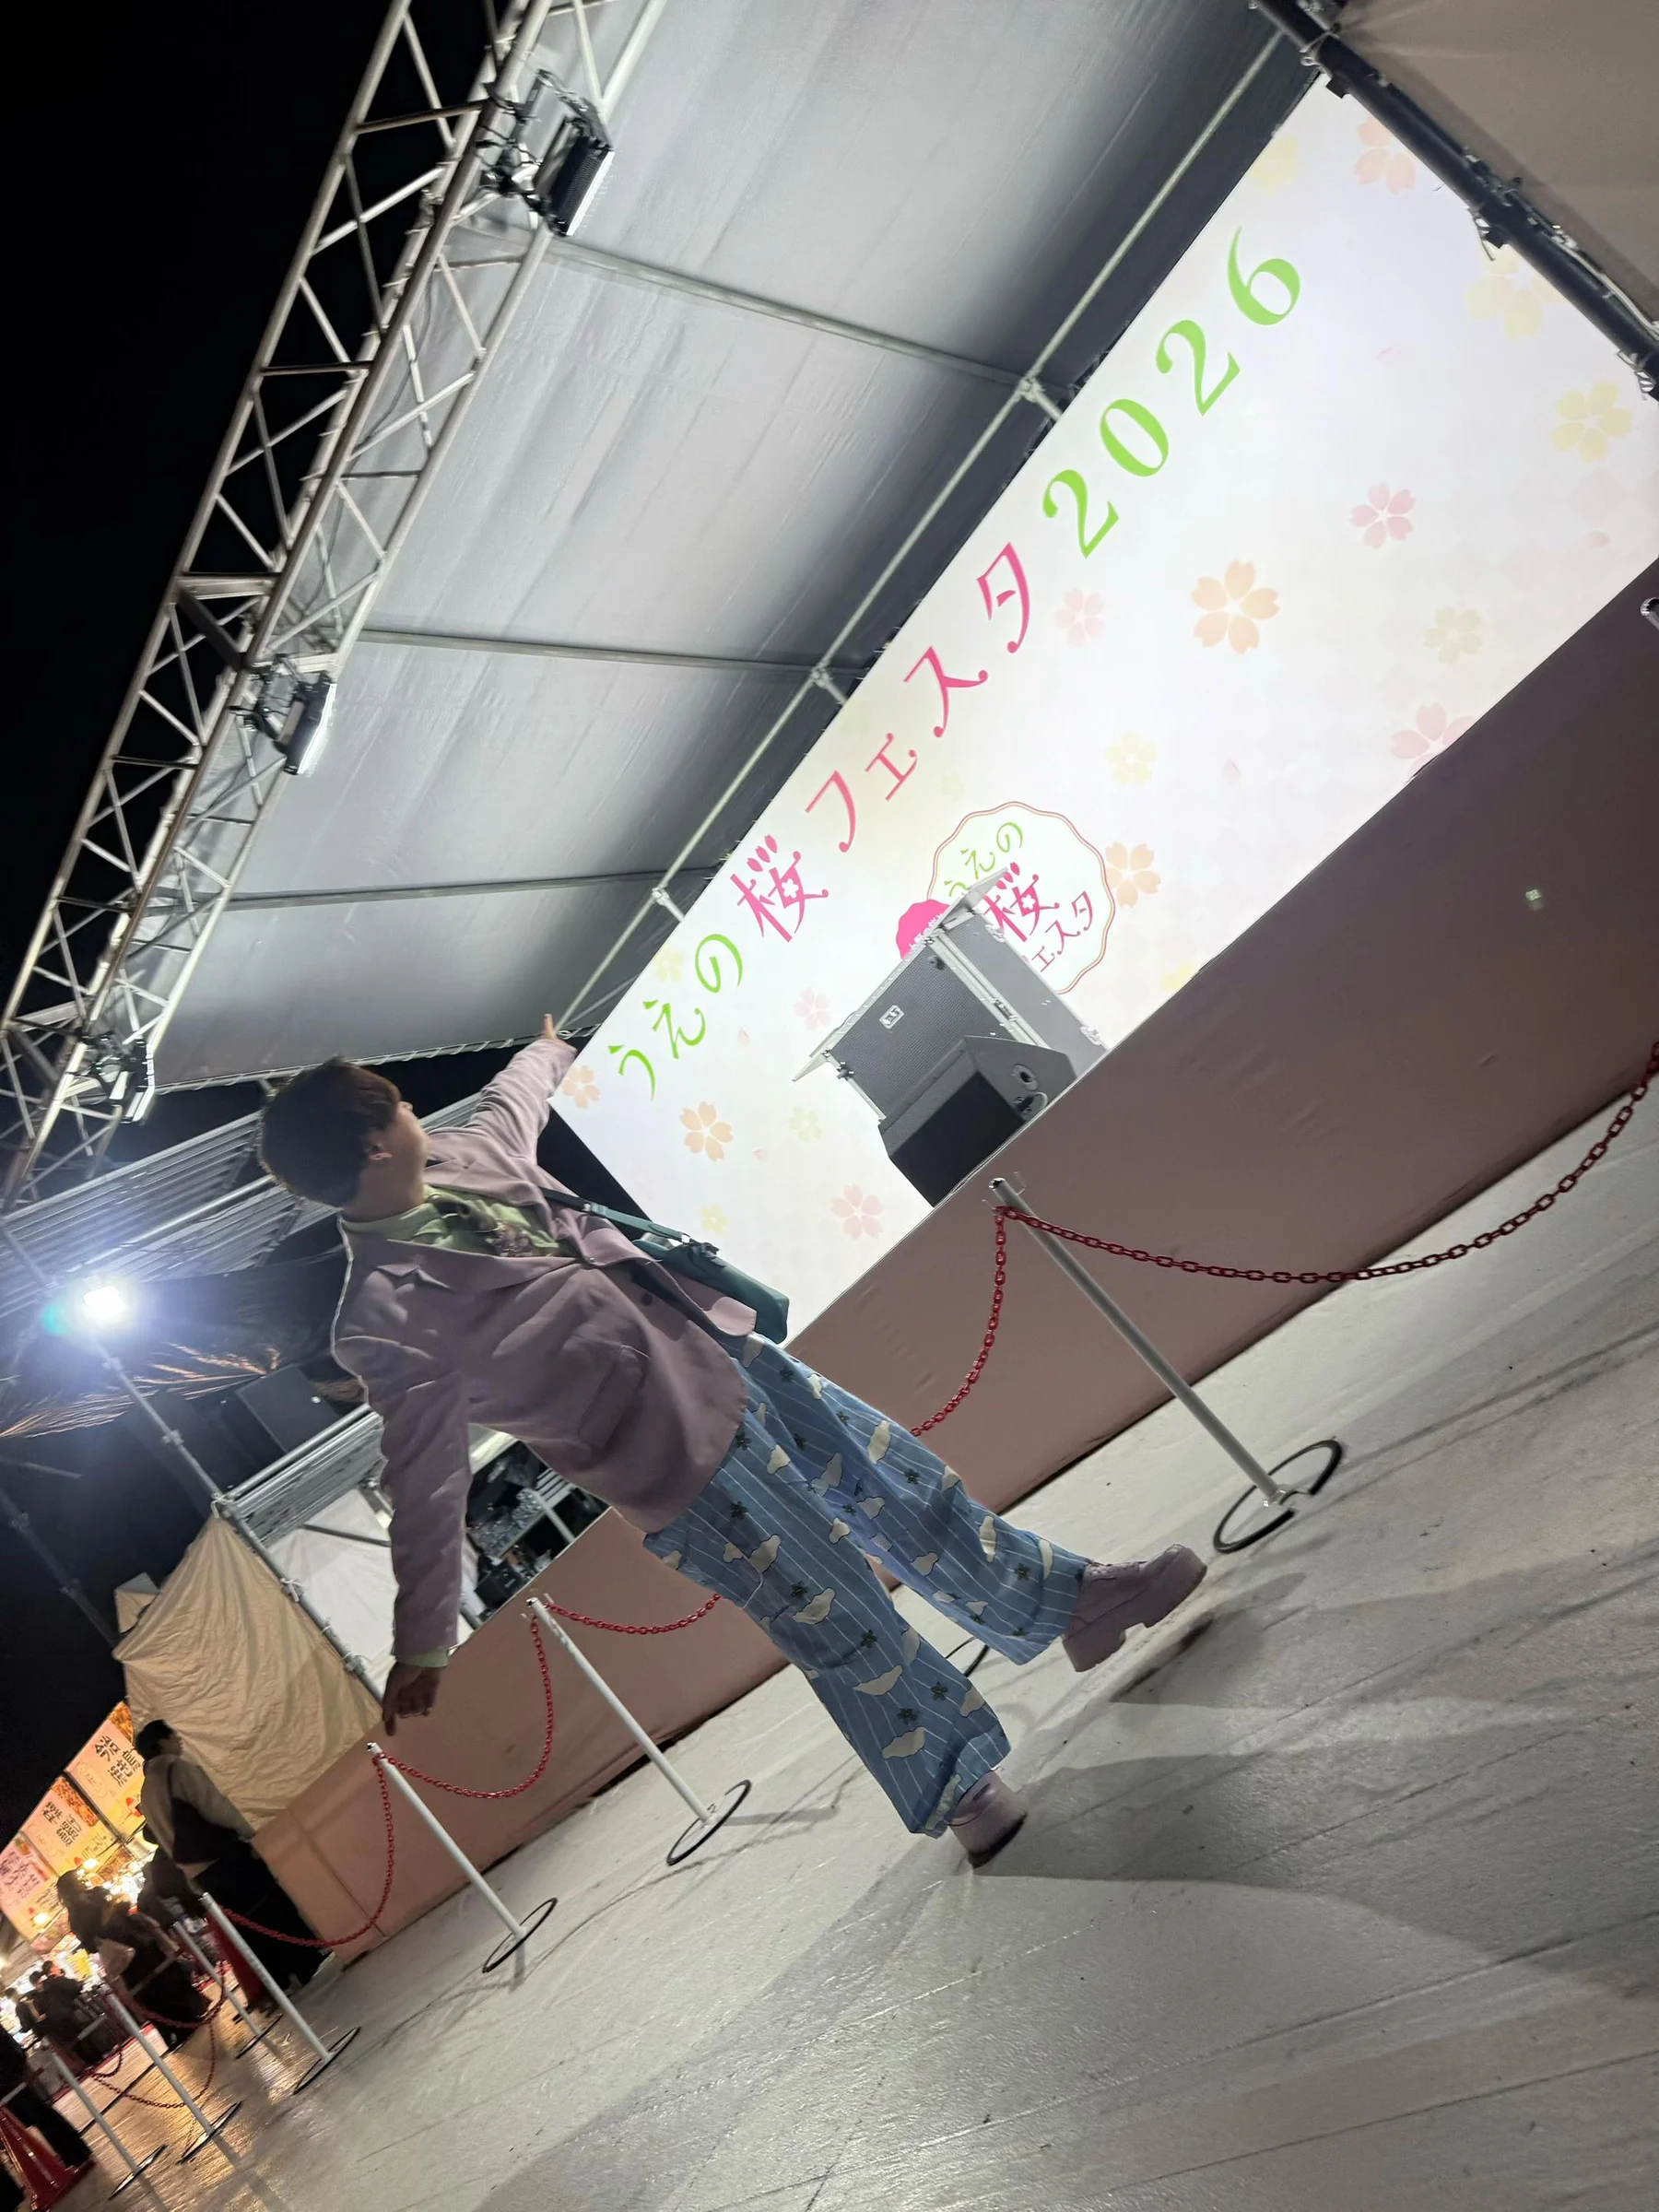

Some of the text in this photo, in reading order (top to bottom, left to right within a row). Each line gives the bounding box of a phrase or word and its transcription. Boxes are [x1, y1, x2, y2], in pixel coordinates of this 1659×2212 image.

[982, 861, 1060, 943] 桜
[1021, 890, 1094, 973] ェスタ
